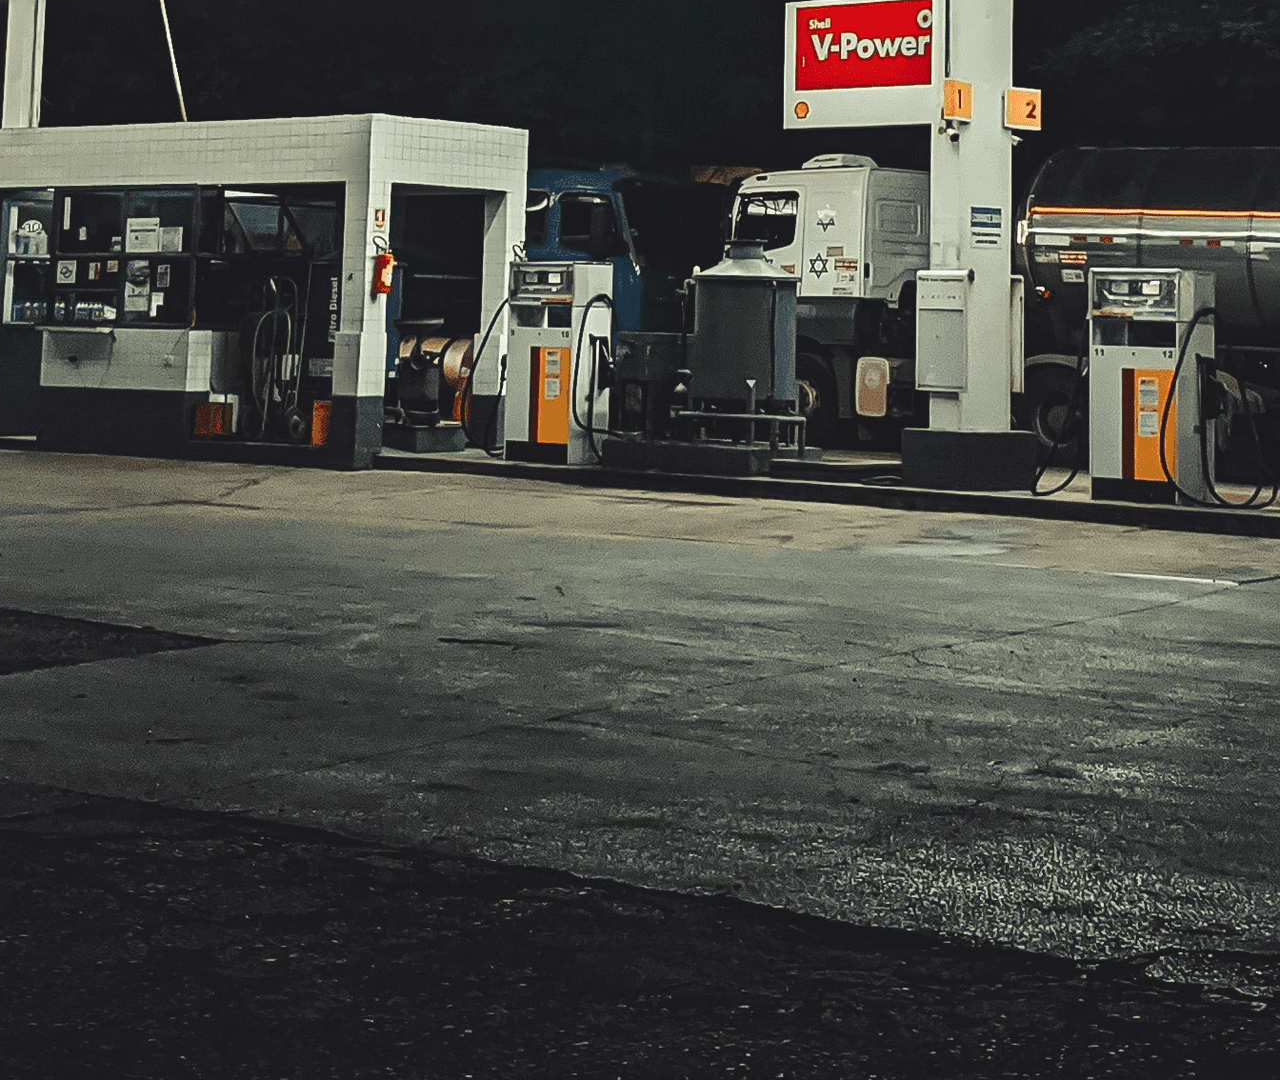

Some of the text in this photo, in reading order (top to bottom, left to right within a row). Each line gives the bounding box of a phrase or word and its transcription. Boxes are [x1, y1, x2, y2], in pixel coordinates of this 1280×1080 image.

[809, 18, 831, 30] Shell
[811, 32, 930, 61] V-Power
[957, 89, 962, 110] 1
[1025, 100, 1037, 119] 2
[329, 277, 338, 311] Diesel
